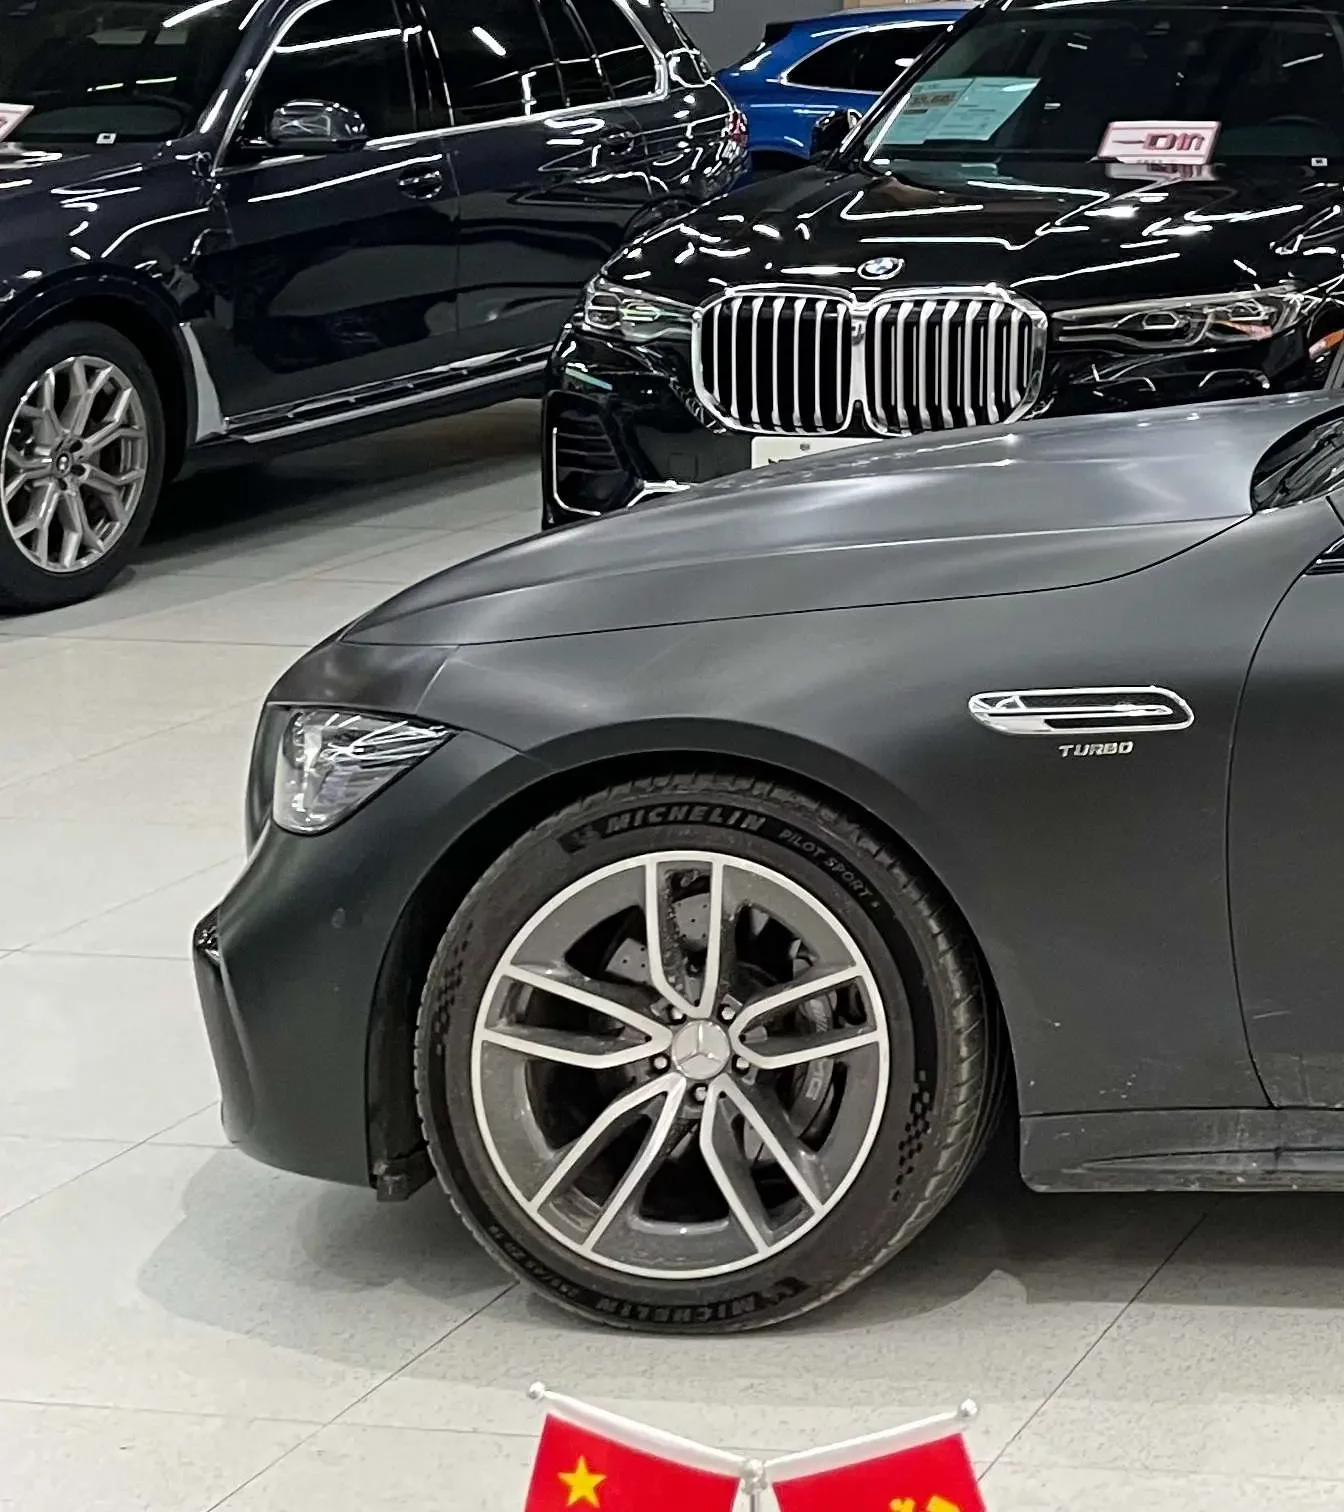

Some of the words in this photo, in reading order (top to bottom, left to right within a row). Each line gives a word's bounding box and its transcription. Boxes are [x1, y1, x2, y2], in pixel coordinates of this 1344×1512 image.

[1058, 740, 1134, 758] TURBO
[604, 804, 768, 835] MICHELIN
[776, 827, 826, 856] PILOT
[826, 855, 871, 899] SPORT
